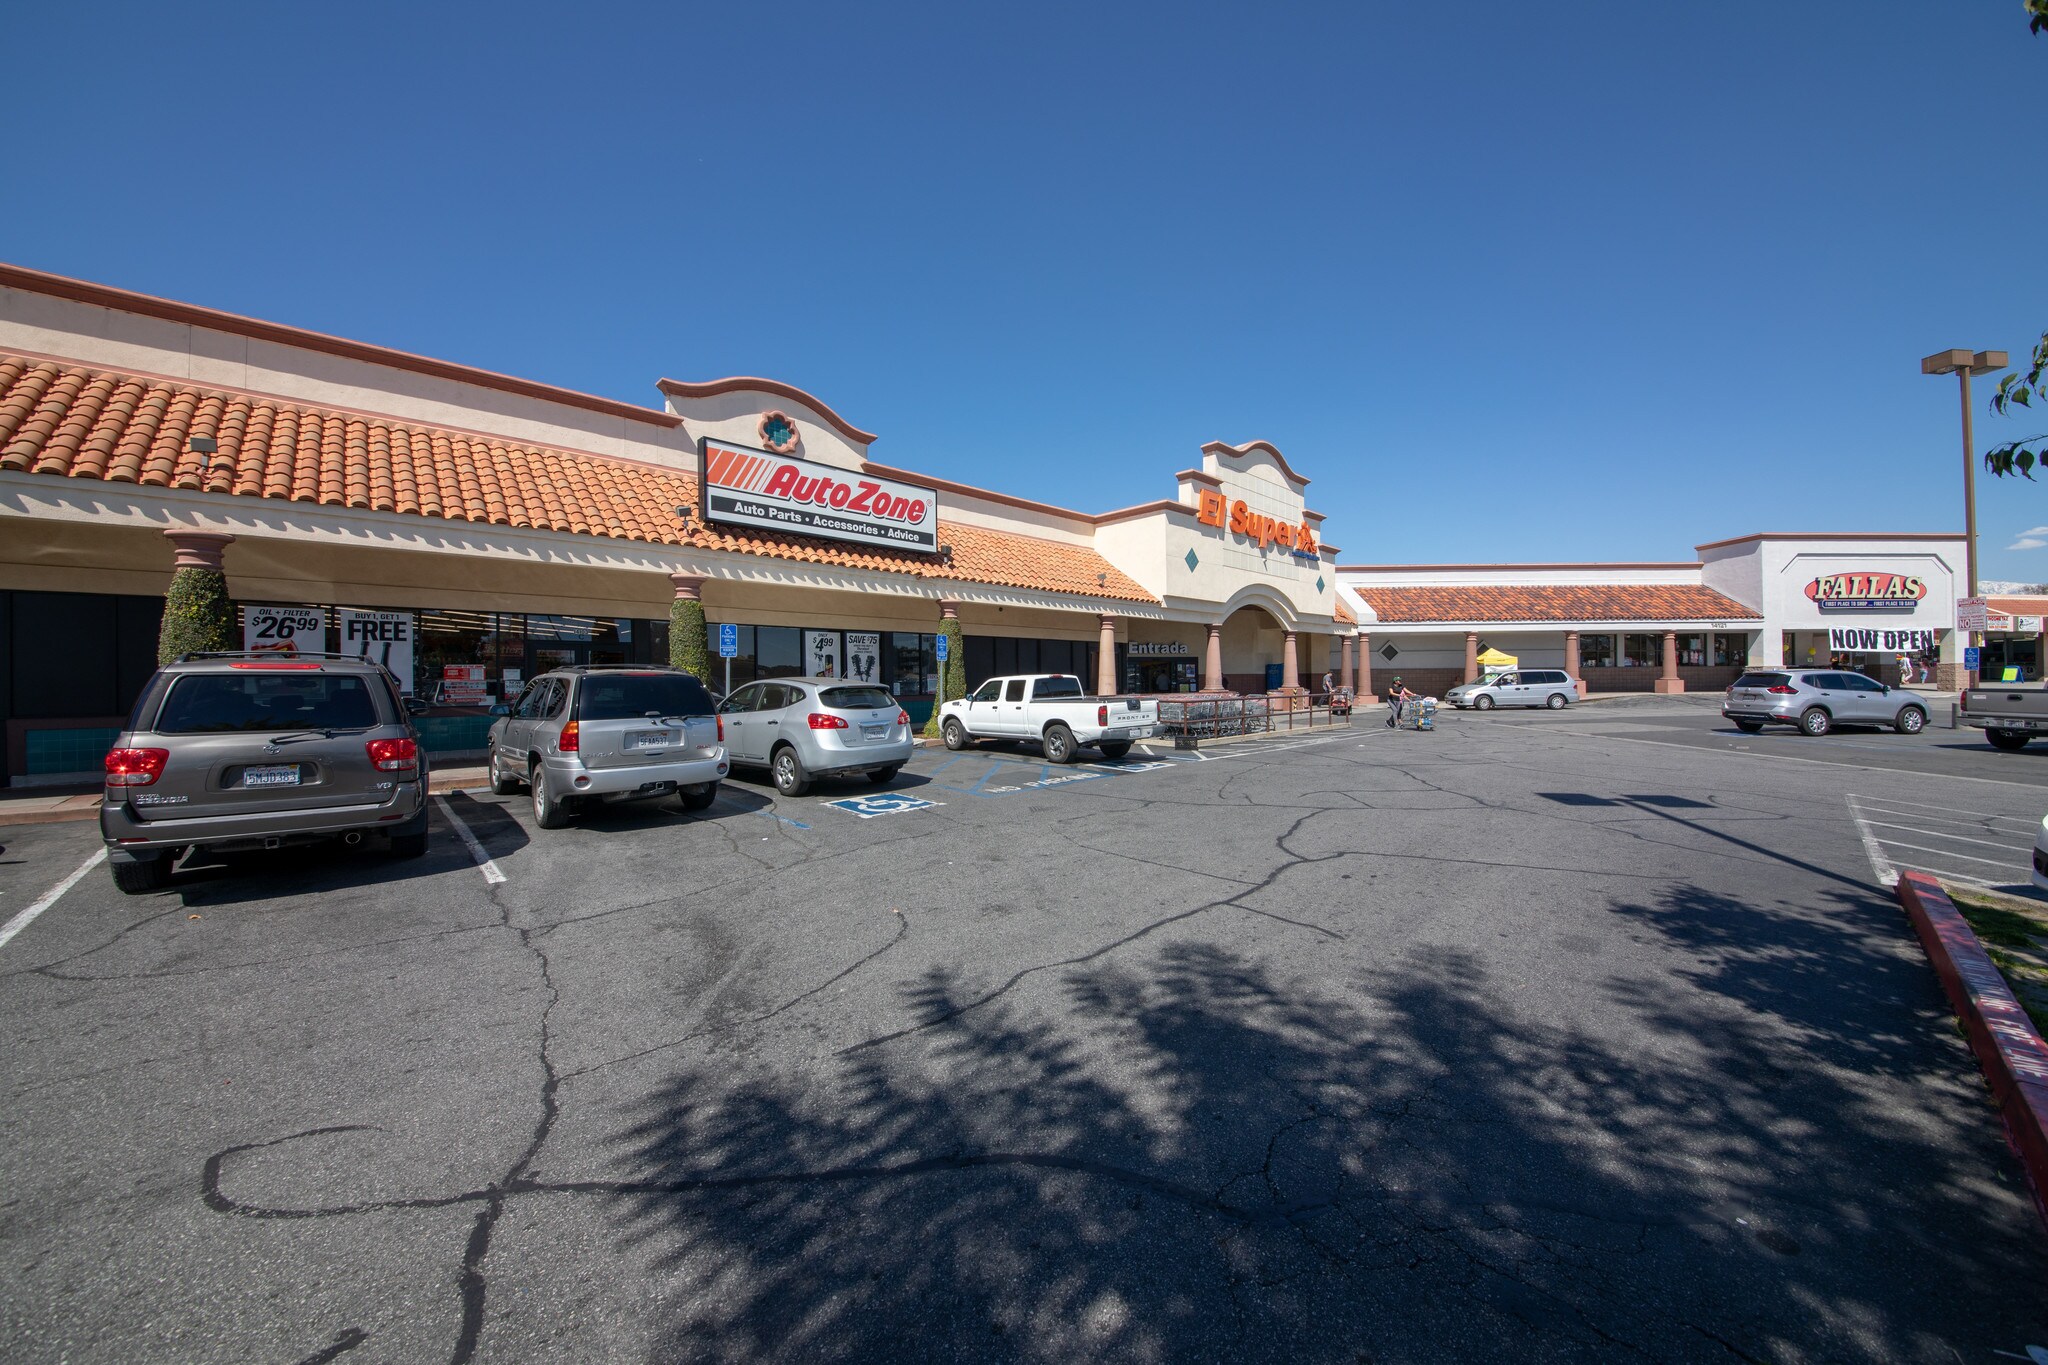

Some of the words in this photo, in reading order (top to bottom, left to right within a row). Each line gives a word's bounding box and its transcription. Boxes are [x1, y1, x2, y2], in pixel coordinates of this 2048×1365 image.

[762, 464, 926, 523] AutoZone
[734, 502, 765, 516] Auto
[768, 507, 802, 522] Parts
[813, 515, 878, 535] Accessories
[887, 528, 919, 541] Advice
[1197, 488, 1227, 528] El
[1229, 500, 1298, 548] Super
[1814, 575, 1922, 599] FALLAS
[283, 609, 311, 617] FILTER
[1960, 619, 1970, 628] NO
[347, 620, 407, 642] FREE
[848, 635, 866, 644] SAVE
[867, 636, 877, 645] $75
[1831, 629, 1879, 650] NOW
[1883, 630, 1934, 651] OPEN
[1128, 641, 1188, 654] Entrada
[985, 785, 1021, 793] NO
[1023, 772, 1101, 787] PARKING
